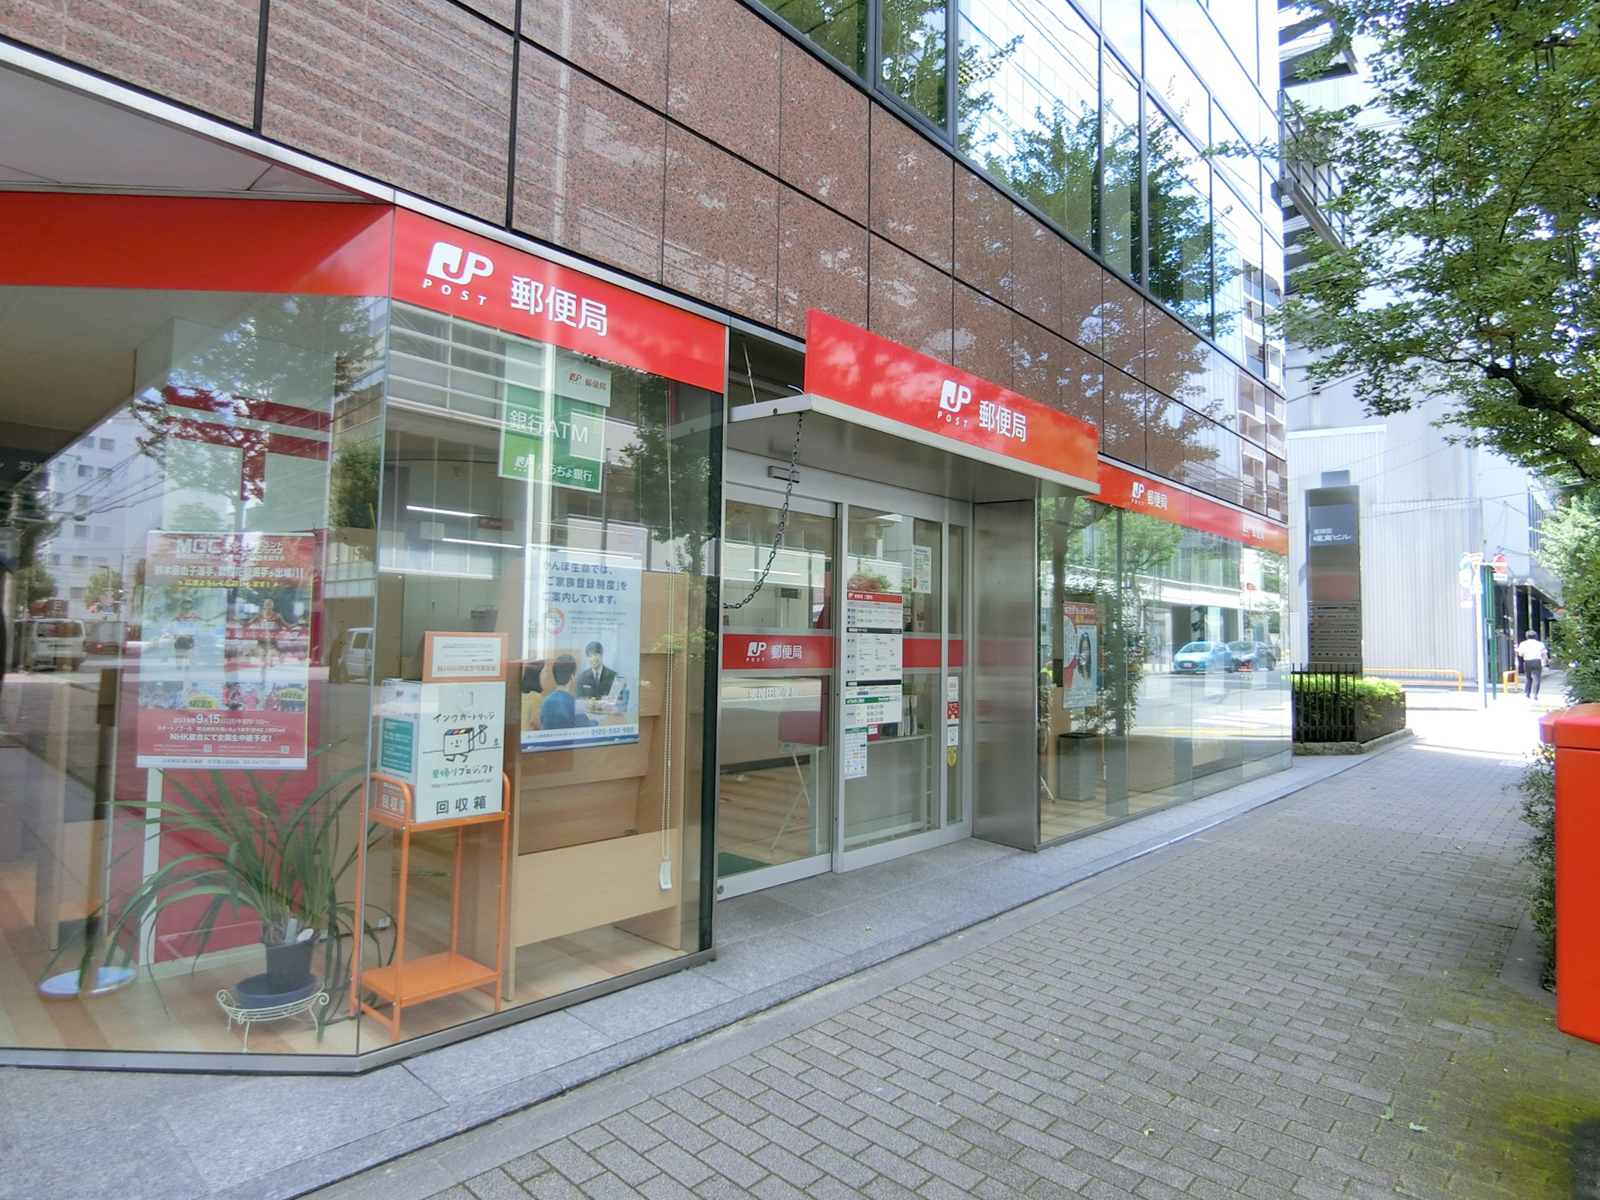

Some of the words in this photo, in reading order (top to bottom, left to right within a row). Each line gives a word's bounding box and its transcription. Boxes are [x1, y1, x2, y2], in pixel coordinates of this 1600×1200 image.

[422, 277, 487, 306] POST
[510, 274, 608, 338] 郵便局
[508, 409, 589, 444] 銀行ATM
[937, 410, 969, 429] POST
[978, 399, 1027, 443] 郵便局
[538, 462, 593, 482] ゆうちょ銀行
[1146, 488, 1168, 511] 郵便局
[175, 537, 222, 554] MGC
[771, 644, 803, 660] 郵便局
[433, 712, 496, 725] インクカートリッジ
[432, 764, 495, 779] 里帰りプロジェクト
[435, 795, 487, 816] 回収箱
